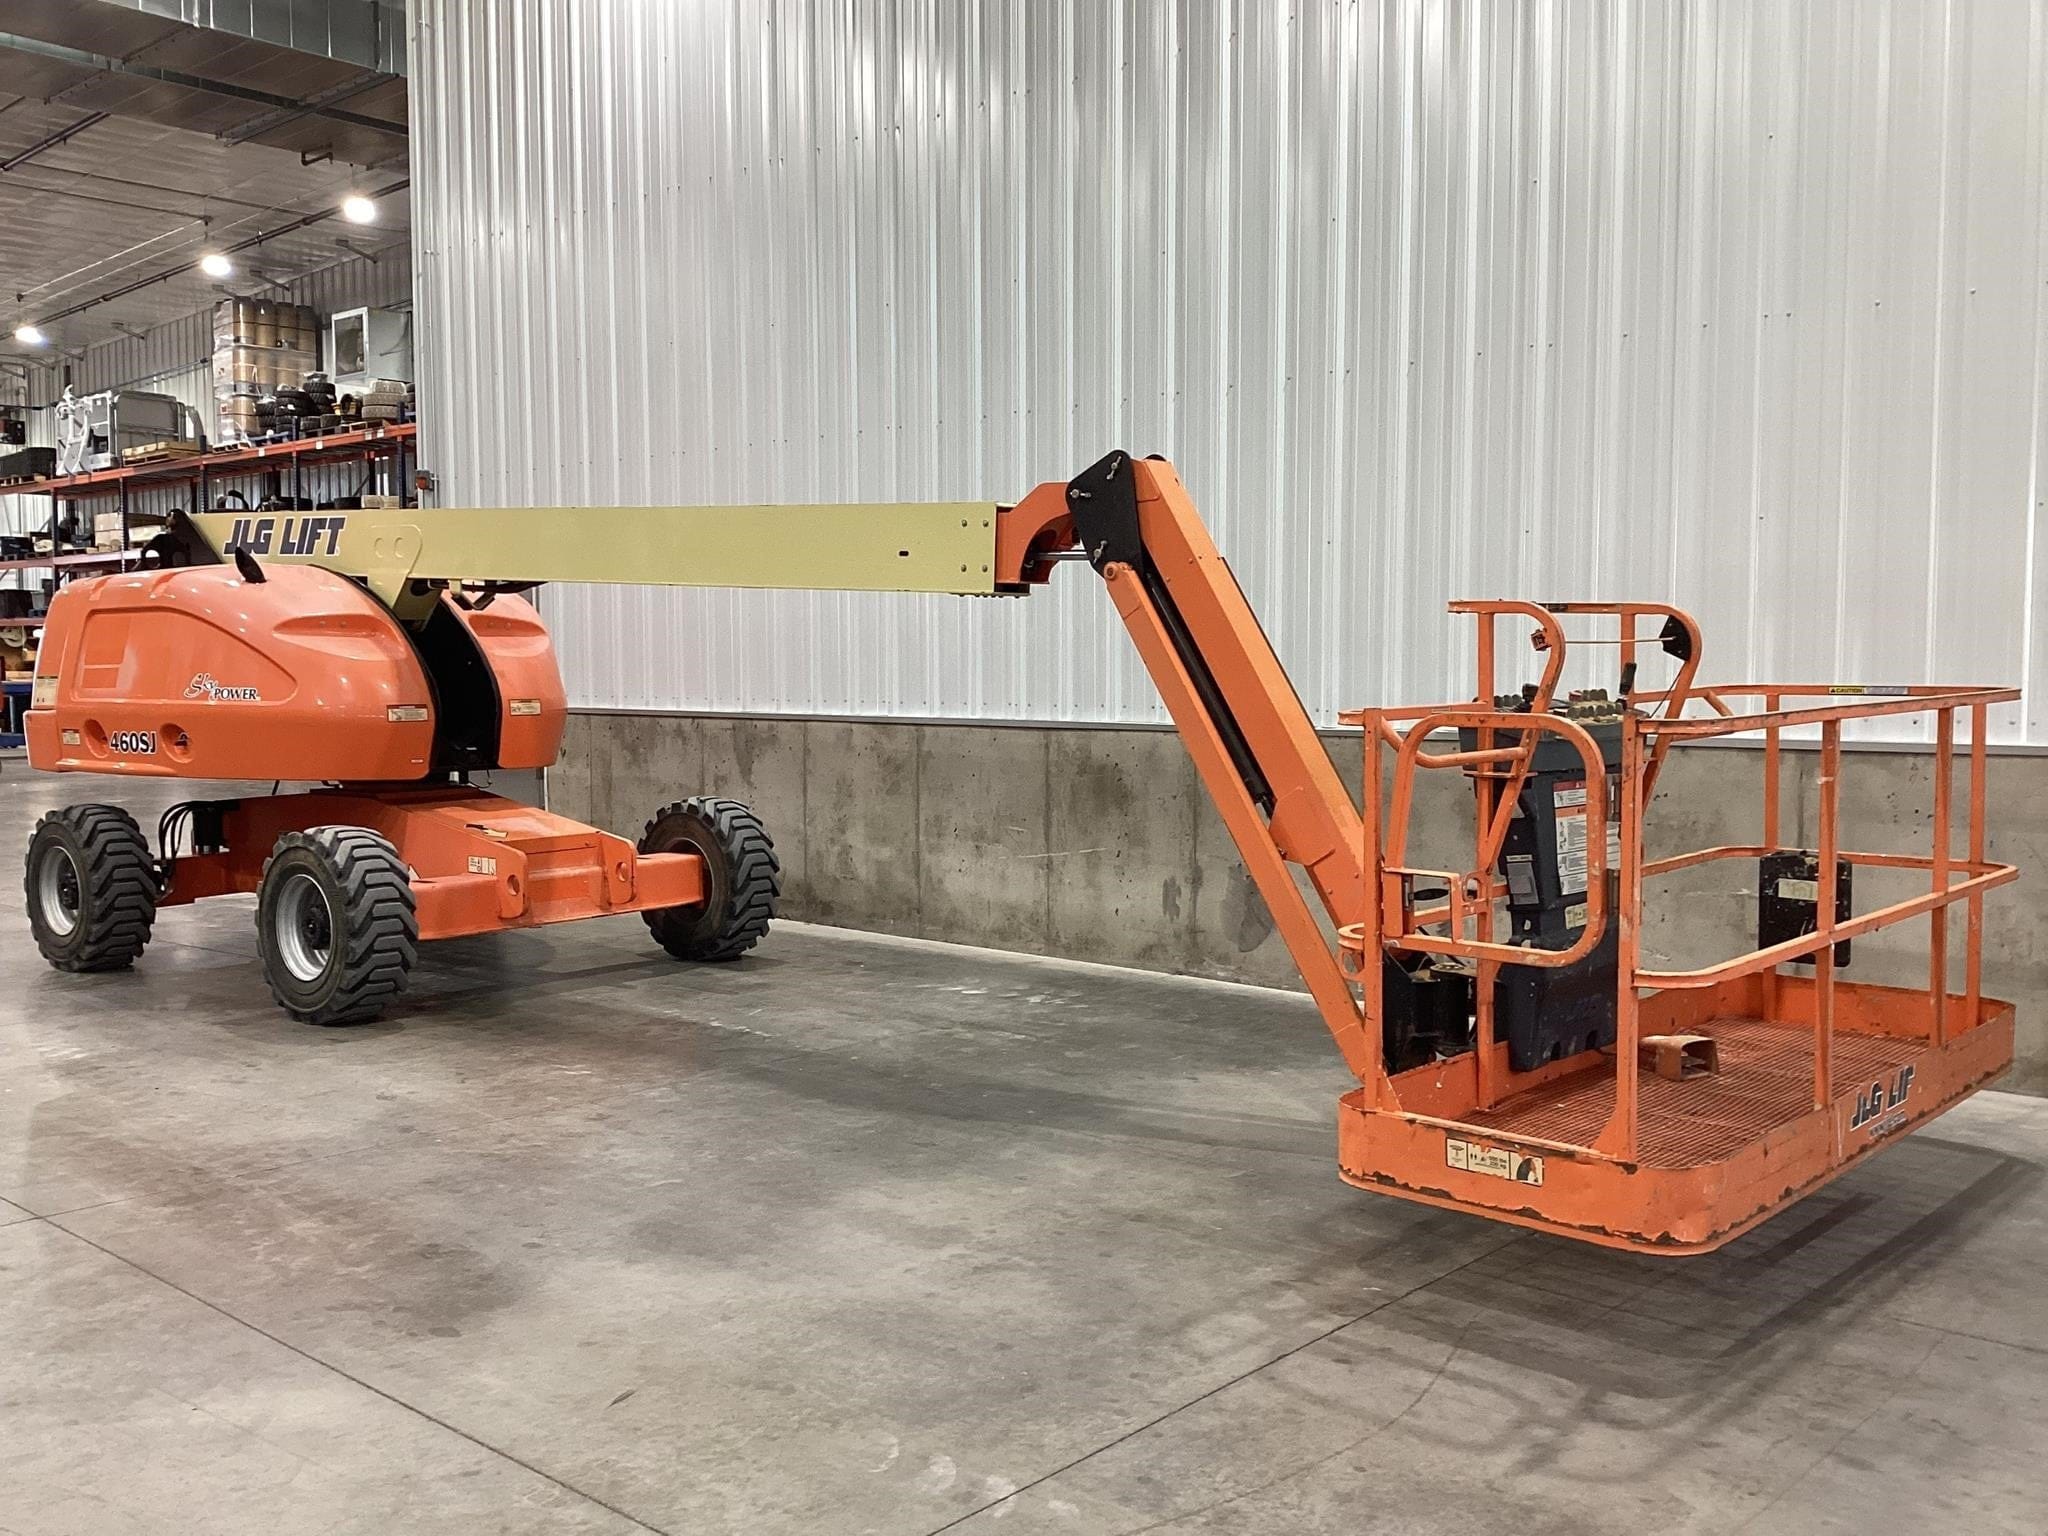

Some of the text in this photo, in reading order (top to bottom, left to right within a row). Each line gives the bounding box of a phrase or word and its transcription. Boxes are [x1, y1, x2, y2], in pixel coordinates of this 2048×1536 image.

[222, 515, 347, 555] JLG LIFT
[214, 688, 257, 701] POWER
[110, 731, 156, 754] 460SJ
[1850, 1081, 1883, 1131] JLG
[1885, 1064, 1916, 1111] LIF
